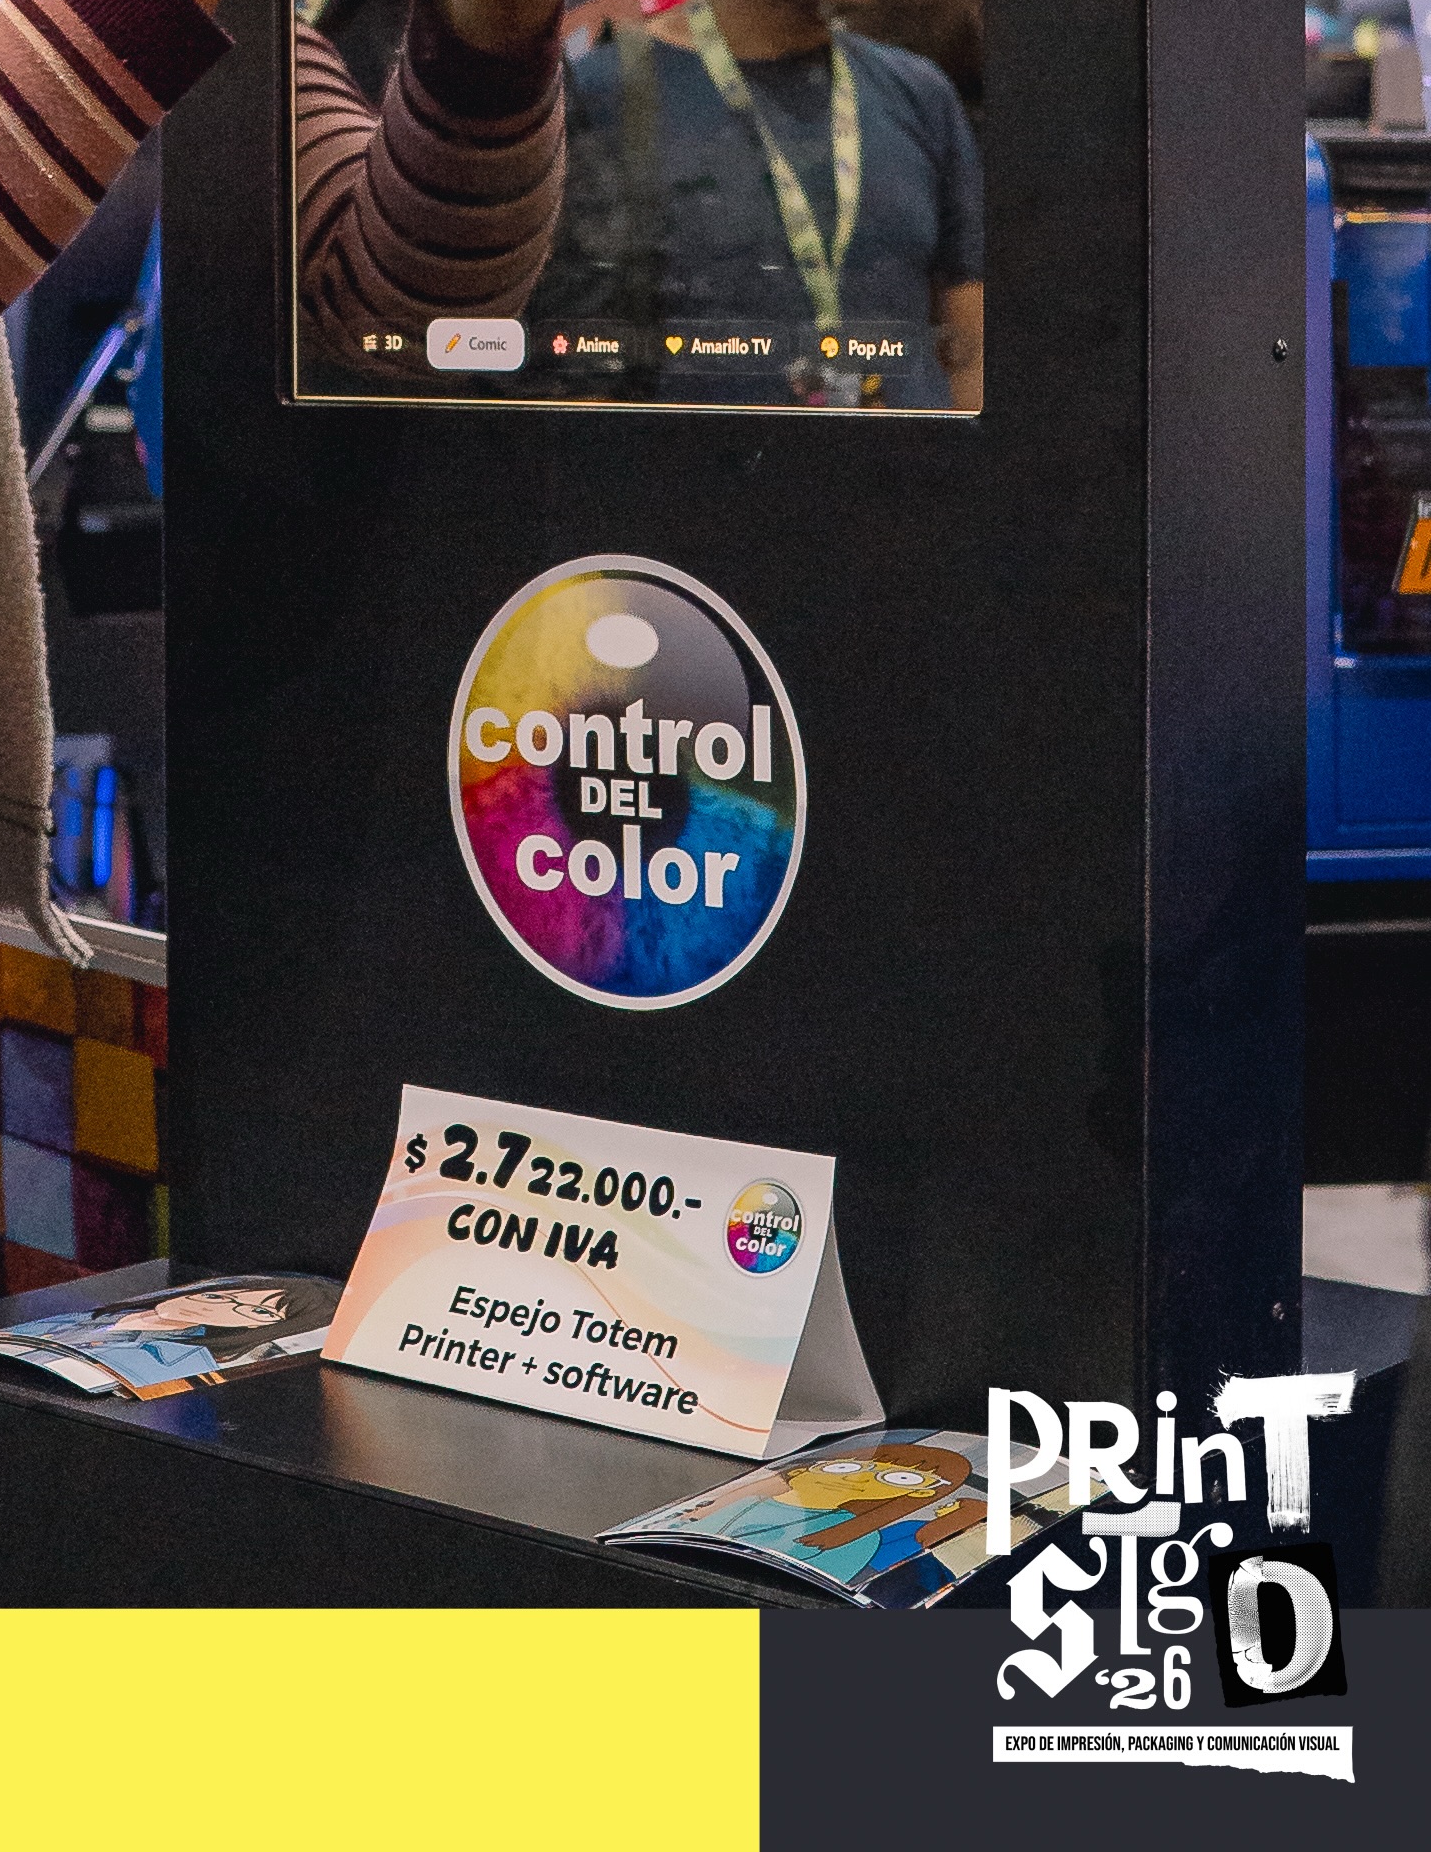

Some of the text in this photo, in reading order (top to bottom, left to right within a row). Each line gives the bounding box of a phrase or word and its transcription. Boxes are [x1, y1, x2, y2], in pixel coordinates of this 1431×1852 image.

[384, 334, 403, 351] 3D
[468, 336, 507, 351] Comic
[576, 336, 620, 354] Anime
[690, 336, 772, 356] Amarillo TV
[848, 339, 904, 361] Pop Art
[465, 698, 772, 783] control
[580, 776, 663, 820] DEL
[515, 824, 740, 909] color
[404, 1133, 428, 1174] $
[730, 1208, 800, 1232] control
[753, 1225, 772, 1238] DEL
[446, 1203, 619, 1270] CON IVA
[735, 1237, 787, 1258] color
[448, 1285, 679, 1360] Espejo Totem
[398, 1323, 700, 1416] Printer + software
